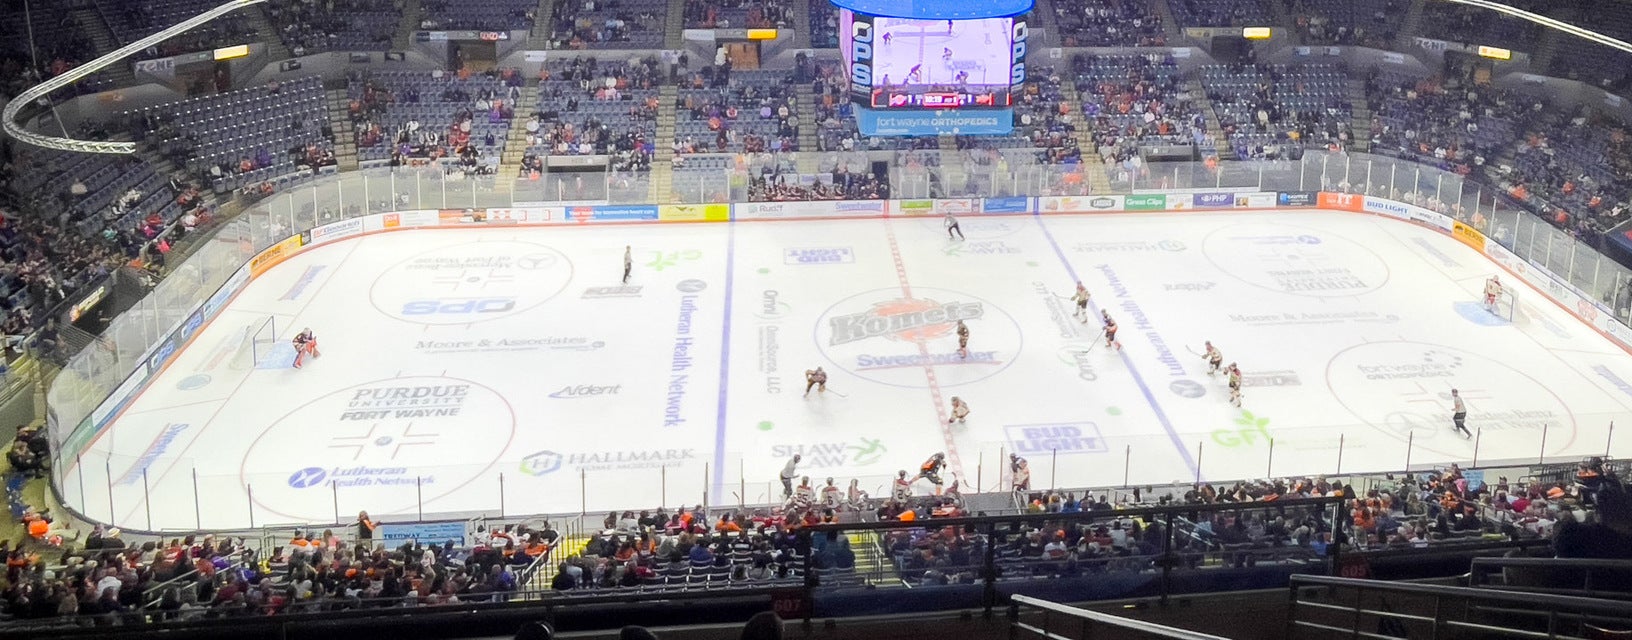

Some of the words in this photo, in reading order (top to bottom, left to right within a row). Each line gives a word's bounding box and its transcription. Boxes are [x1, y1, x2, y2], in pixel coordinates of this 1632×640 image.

[852, 21, 872, 86] OPS
[1011, 21, 1028, 84] OPS
[877, 117, 900, 127] fort
[902, 118, 929, 130] wayne
[931, 117, 998, 126] ORTHOPEDICS
[1126, 198, 1145, 206] Great
[1146, 198, 1163, 206] Clips
[1211, 194, 1227, 202] PHP
[1366, 200, 1384, 208] BUD
[1385, 203, 1409, 214] LIGHT
[677, 295, 699, 334] Lutheran
[829, 299, 984, 347] Komets
[415, 339, 475, 350] Moore
[495, 335, 587, 347] Associates
[672, 337, 693, 371] Health
[766, 376, 781, 394] LLC
[352, 384, 470, 401] PURDUE
[348, 397, 465, 408] UNIVERSITY
[664, 374, 689, 427] Network
[341, 410, 391, 421] FORT
[395, 408, 461, 418] WAYNE
[1021, 426, 1082, 439] BUD
[771, 442, 847, 458] SHAW
[1014, 437, 1100, 451] LIGHT
[569, 447, 695, 465] HALLMARK
[331, 466, 408, 478] Lutheran
[325, 476, 373, 488] Health
[774, 599, 801, 611] 607
